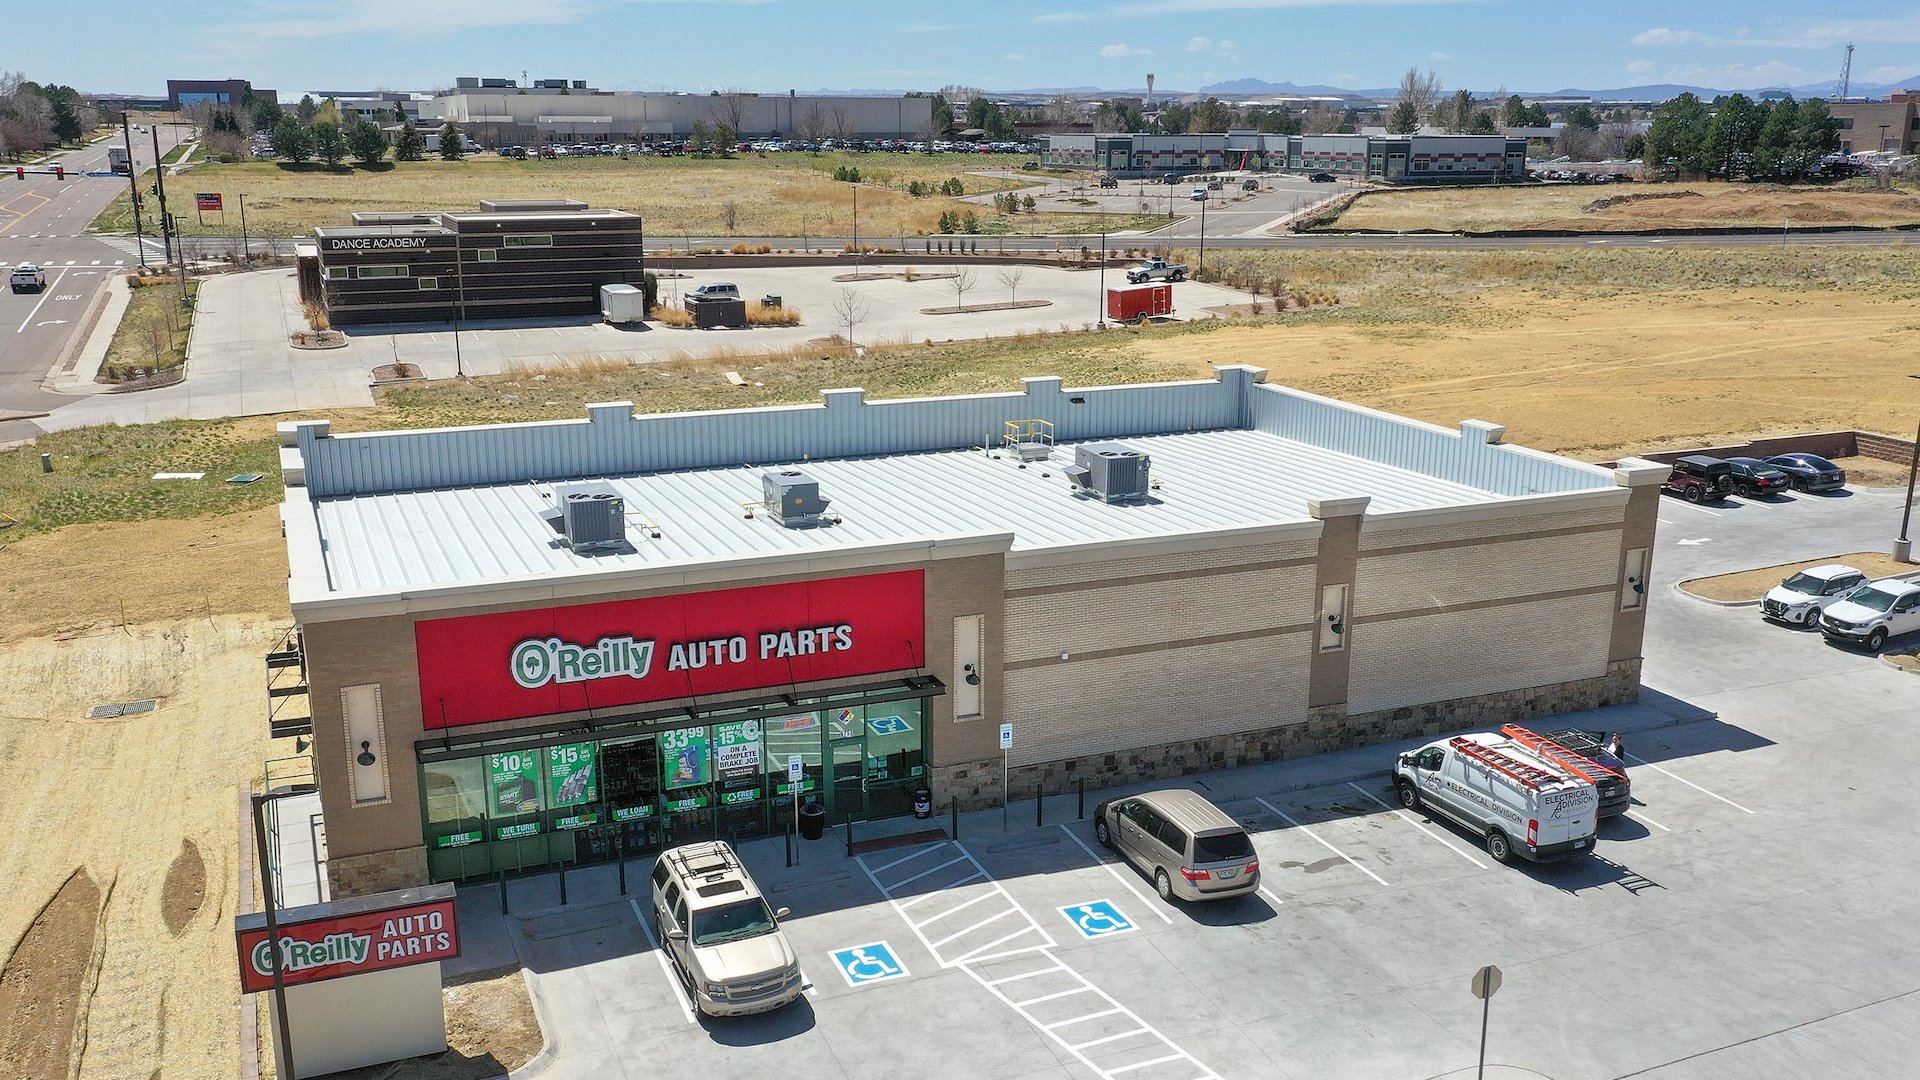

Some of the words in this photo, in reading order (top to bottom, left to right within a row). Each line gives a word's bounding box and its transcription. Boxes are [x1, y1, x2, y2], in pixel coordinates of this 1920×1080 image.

[332, 239, 371, 249] DANCE
[373, 238, 427, 248] ACADEMY
[511, 638, 654, 688] O'Reilly
[668, 637, 747, 671] AUTO
[760, 625, 853, 660] PARTS
[719, 724, 742, 732] SAVE
[719, 731, 743, 744] 15%
[551, 747, 578, 764] $15
[720, 751, 757, 761] COMPLETE
[492, 755, 521, 772] $10
[719, 759, 743, 768] BRAKE
[744, 757, 759, 765] JOB
[737, 790, 754, 798] FREE
[1545, 790, 1589, 804] ELECTRICAL
[678, 799, 696, 807] FREE
[1451, 783, 1489, 808] ELECTRICAL
[1491, 803, 1523, 824] DIVISION
[1562, 795, 1593, 809] DIVISION
[629, 806, 649, 814] LOAN
[561, 816, 579, 825] FREE
[502, 826, 514, 834] WE
[515, 823, 535, 832] TURN
[450, 833, 470, 843] FREE
[252, 935, 371, 976] O'Reilly
[382, 911, 443, 939] AUTO
[377, 931, 450, 961] PARTS
